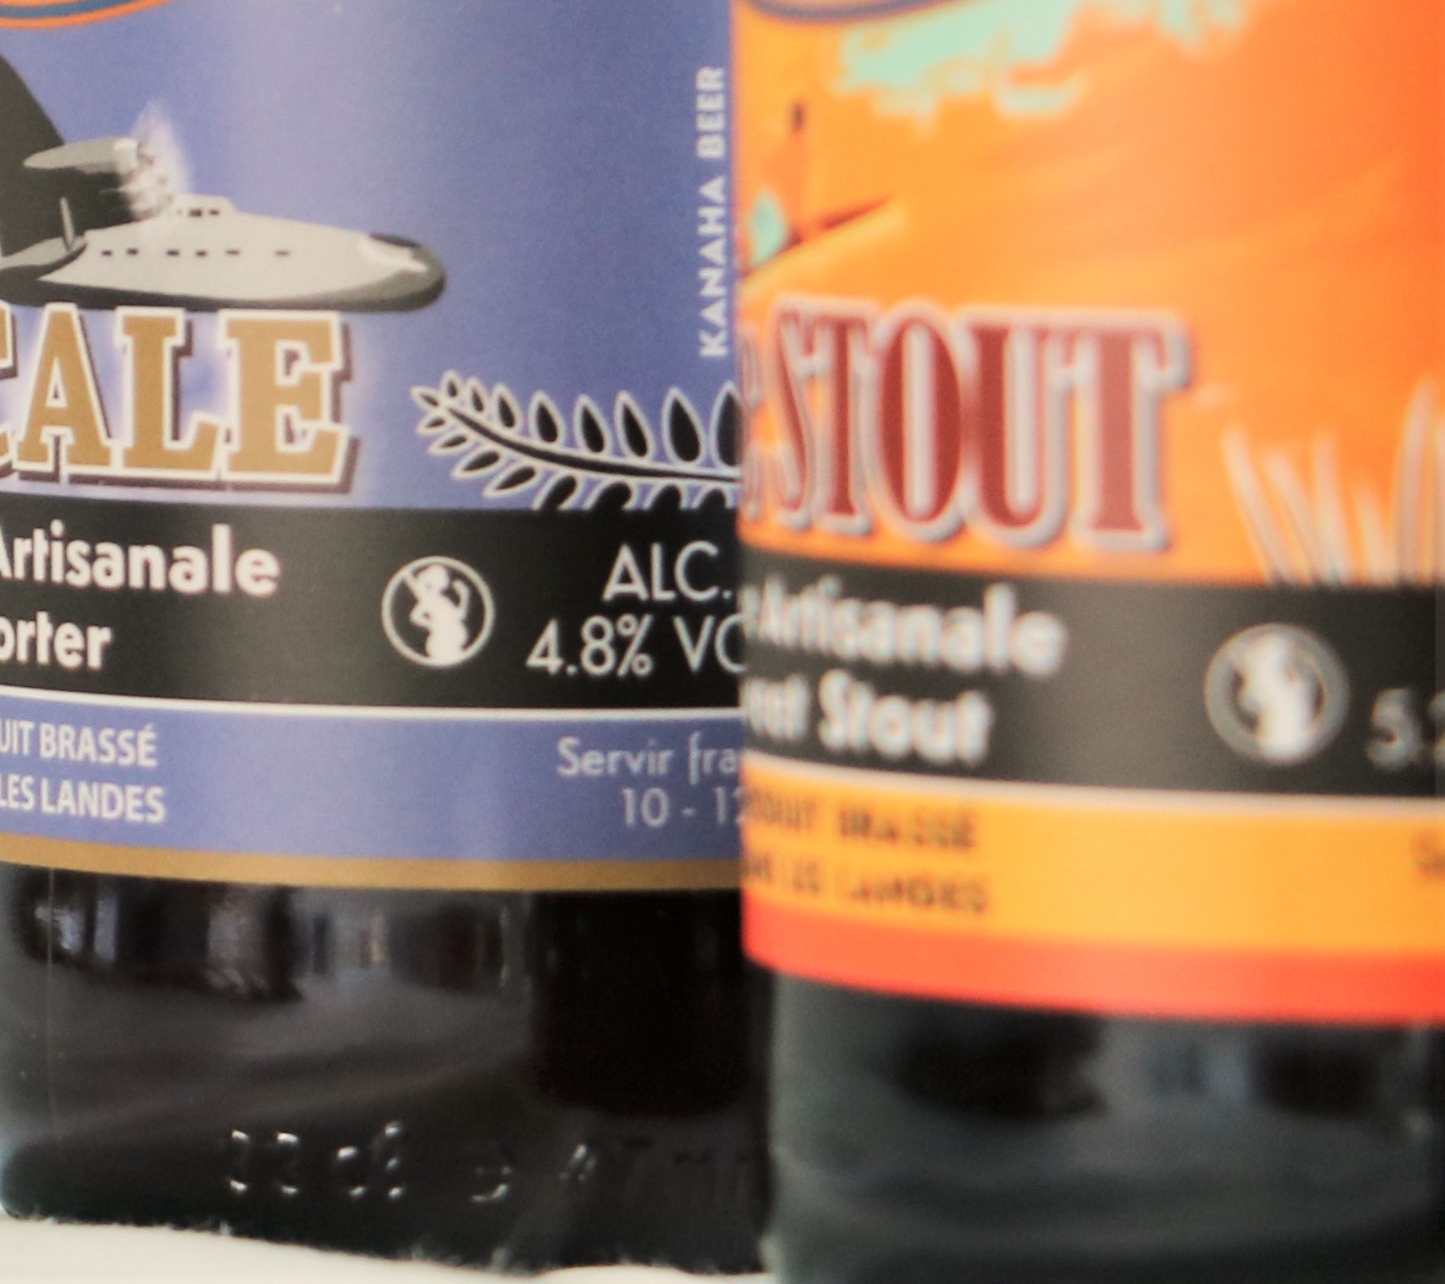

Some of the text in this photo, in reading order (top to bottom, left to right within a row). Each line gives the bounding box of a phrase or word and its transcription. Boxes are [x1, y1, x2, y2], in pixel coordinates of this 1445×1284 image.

[695, 65, 728, 359] KANAHA BEER
[771, 291, 1194, 553] STOUT
[601, 540, 733, 602] ALC.
[524, 613, 654, 676] 4.8%
[759, 575, 1066, 679] Artisanale
[38, 722, 159, 768] BRASSÉ
[818, 669, 995, 767] Stout
[556, 735, 675, 777] Servir
[39, 776, 167, 823] LANDES
[621, 786, 670, 827] 10
